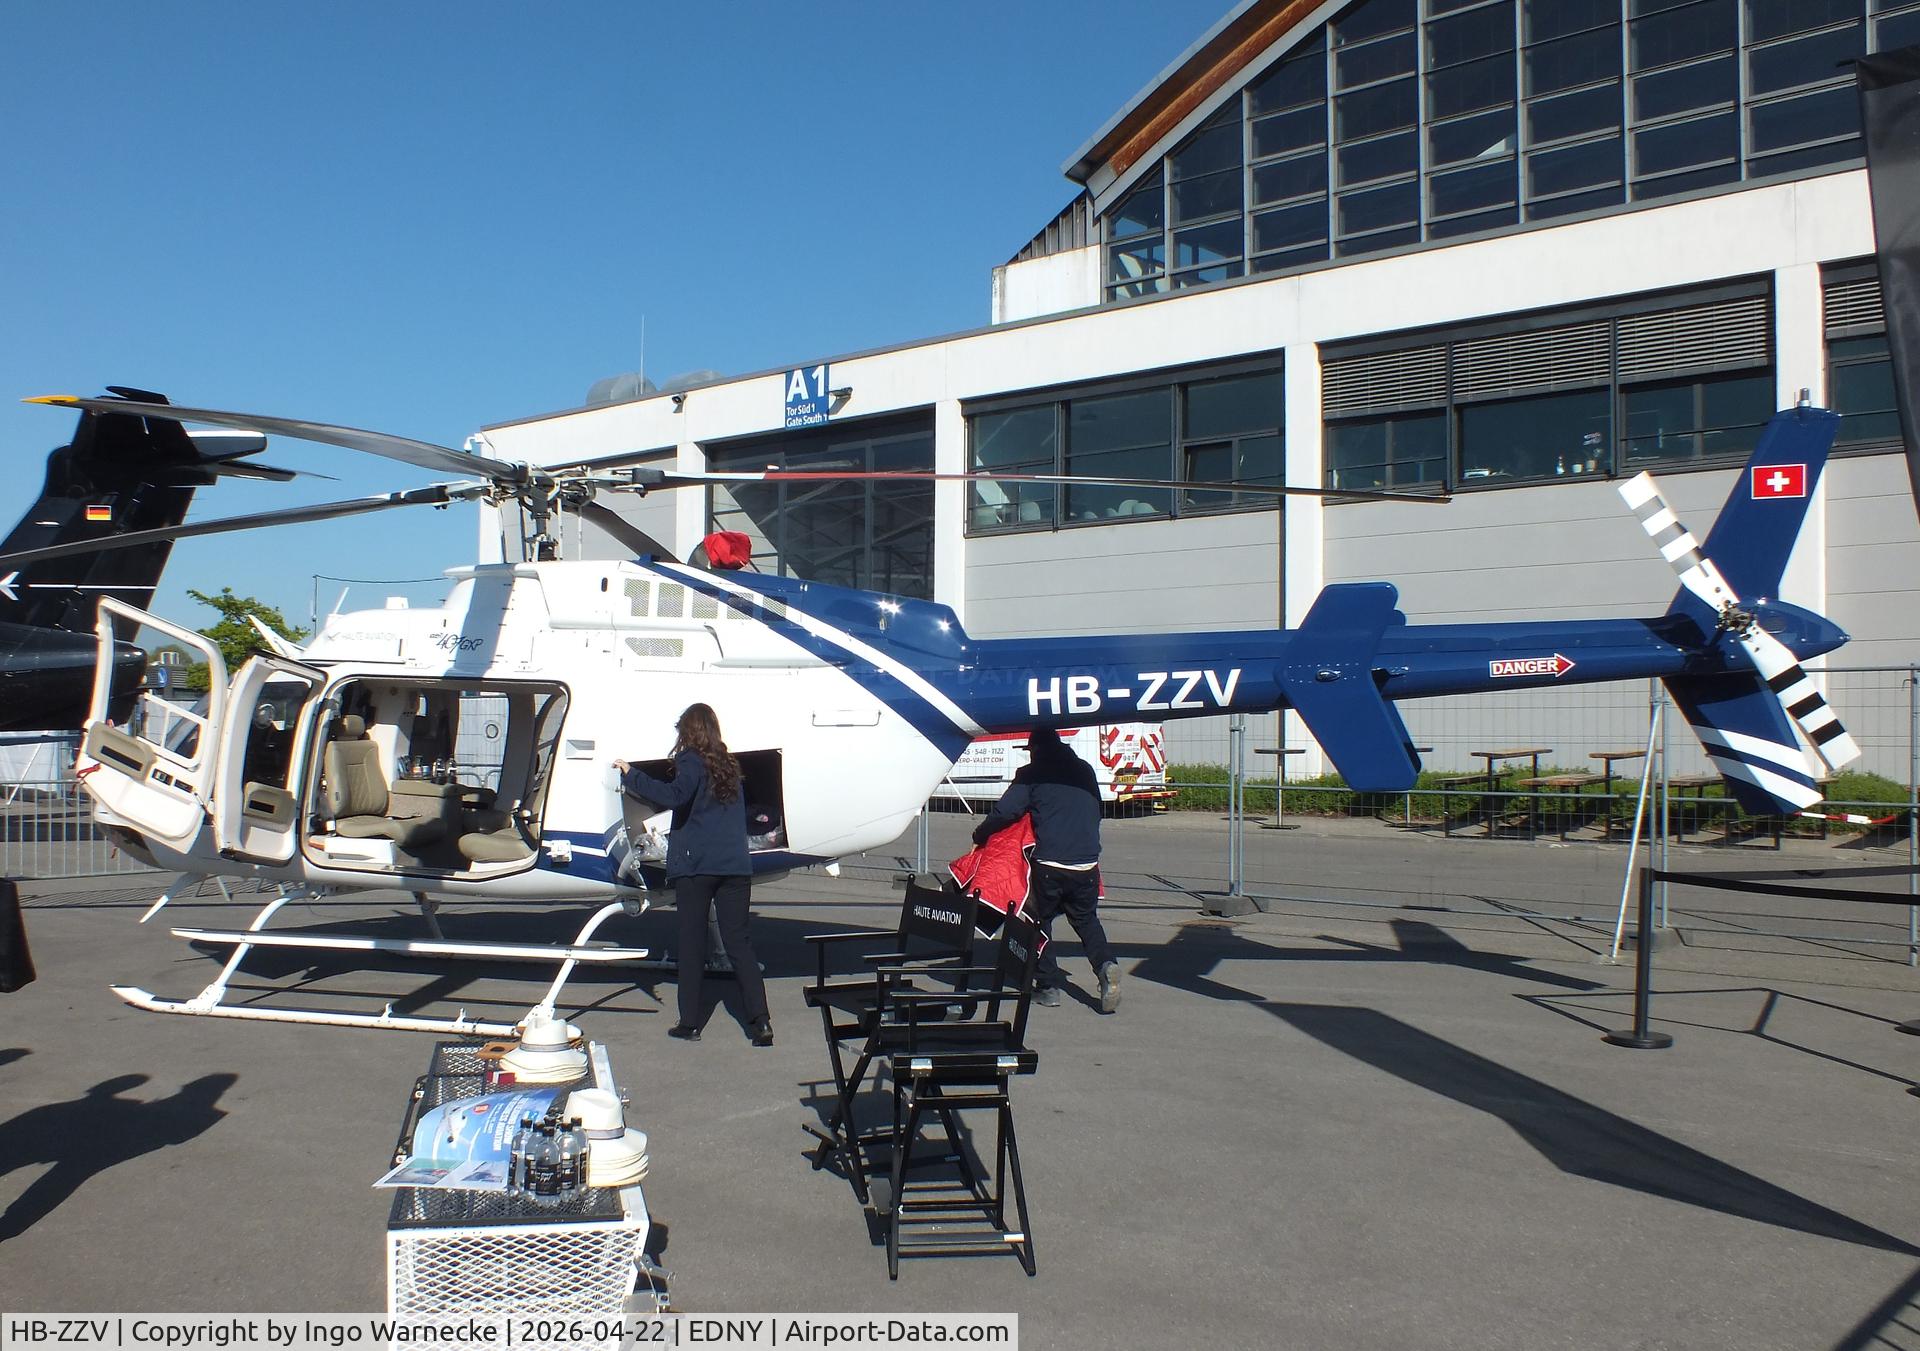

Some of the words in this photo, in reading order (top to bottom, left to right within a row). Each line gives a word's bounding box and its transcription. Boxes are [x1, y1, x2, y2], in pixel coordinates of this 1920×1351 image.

[786, 406, 798, 416] Tor
[798, 403, 811, 414] Süd
[811, 402, 816, 412] 1
[786, 417, 802, 427] Gate
[803, 412, 821, 424] South
[1492, 660, 1559, 675] DANGER
[1028, 668, 1242, 716] HB-ZZV
[913, 904, 931, 919] HAUTE
[931, 908, 962, 925] AVIATION
